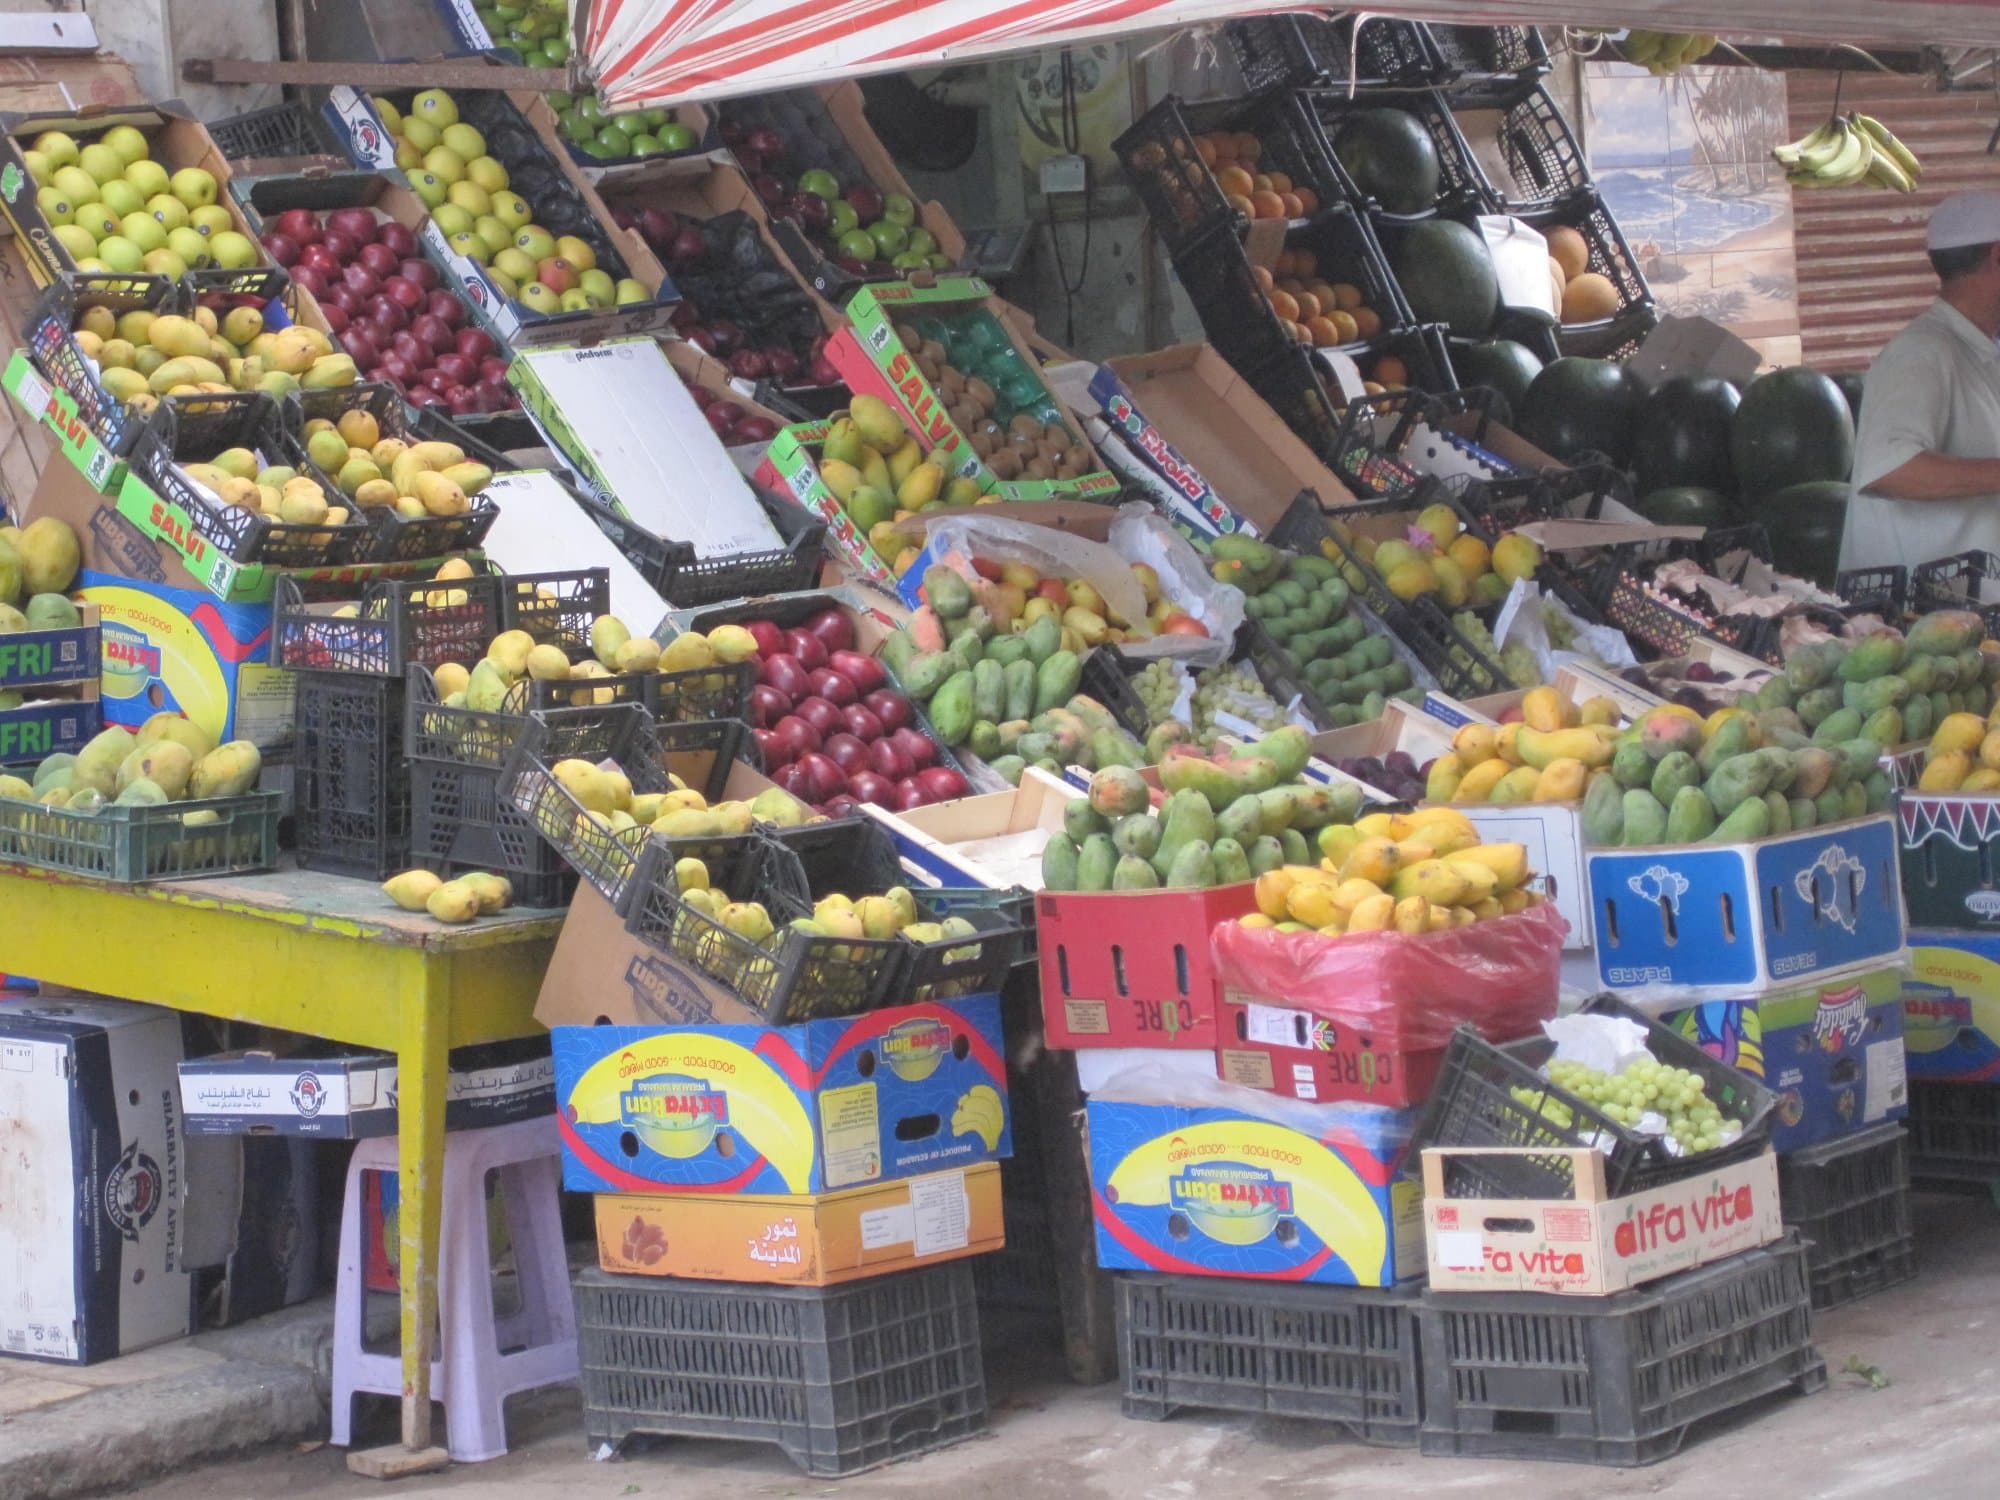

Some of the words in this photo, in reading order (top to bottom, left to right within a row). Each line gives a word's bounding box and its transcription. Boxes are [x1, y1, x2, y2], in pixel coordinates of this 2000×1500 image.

[887, 352, 960, 453] SALVI
[48, 397, 87, 449] ALVI
[149, 503, 206, 563] SALVI
[1608, 966, 1672, 982] PEARS
[1773, 952, 1817, 974] PEARS
[624, 1094, 726, 1120] ExtraBan
[162, 1089, 177, 1200] SHARBATLY
[929, 1150, 940, 1160] OF
[941, 1144, 972, 1158] PRODUCT
[1242, 1143, 1270, 1158] FOOD
[1270, 1148, 1302, 1166] GOOD
[896, 1152, 929, 1166] ECUADOR
[1229, 1168, 1269, 1181] PREMIUM
[1174, 1179, 1291, 1210] ExtraBan
[763, 1217, 797, 1243] تمور
[1614, 1202, 1687, 1258] alfa
[1691, 1178, 1754, 1234] vita
[165, 1205, 177, 1273] APPLES
[748, 1238, 802, 1269] المدينة
[1518, 1242, 1585, 1275] vita
